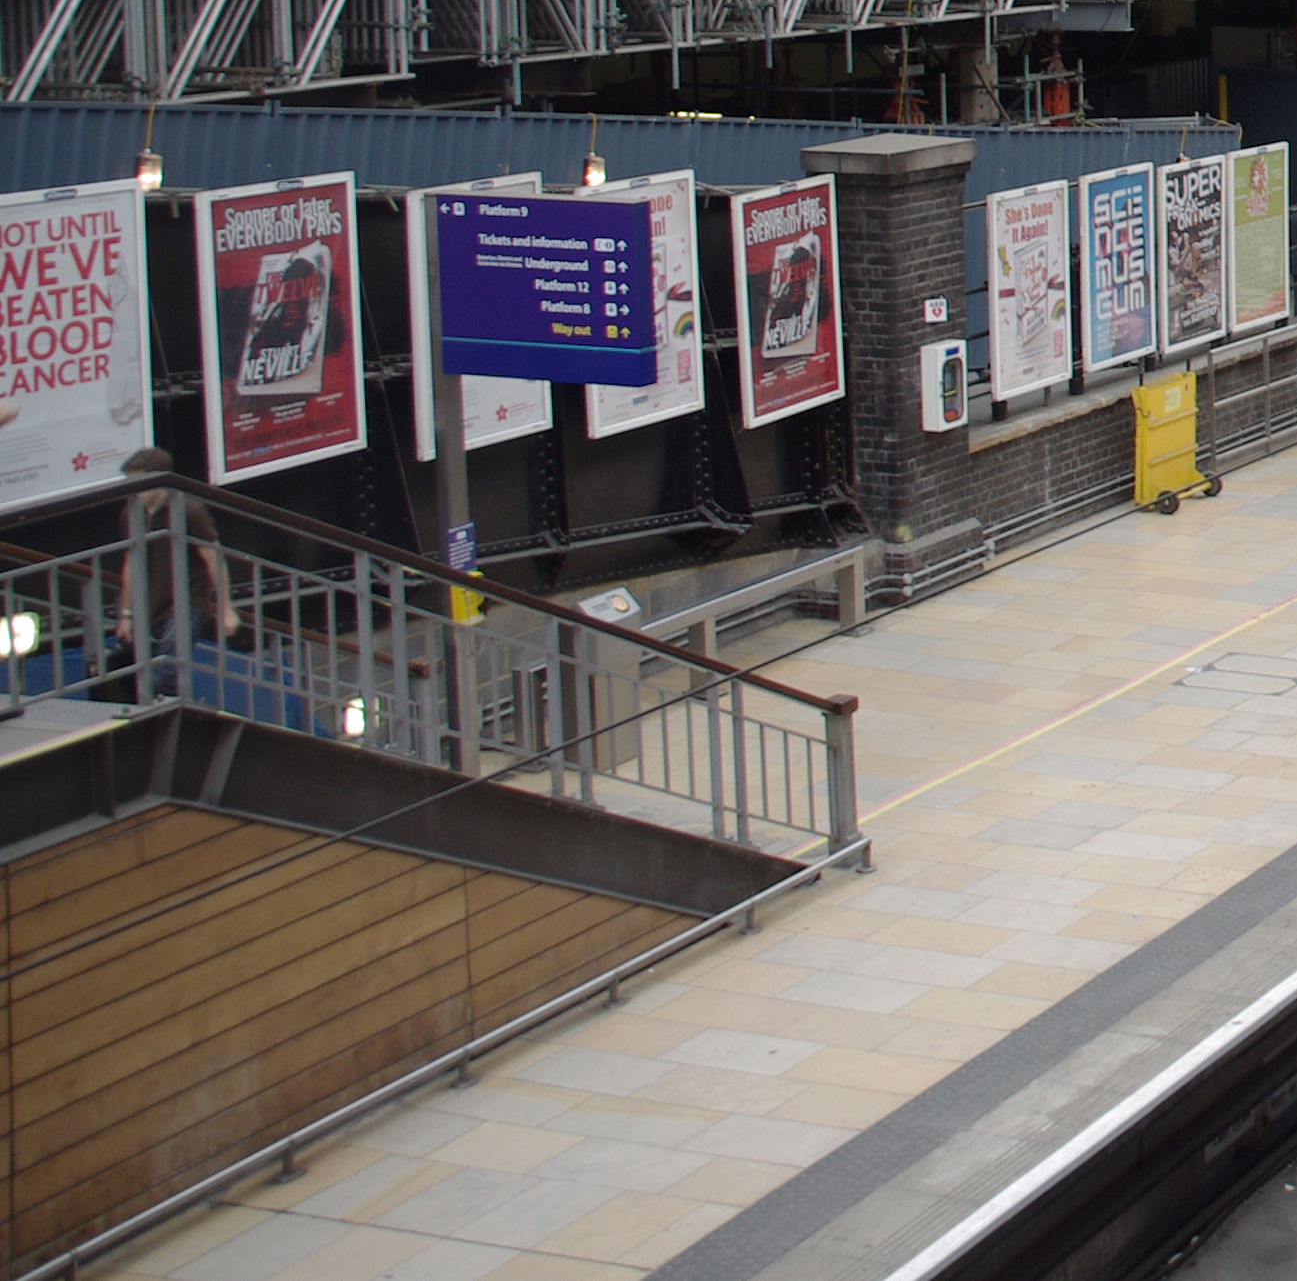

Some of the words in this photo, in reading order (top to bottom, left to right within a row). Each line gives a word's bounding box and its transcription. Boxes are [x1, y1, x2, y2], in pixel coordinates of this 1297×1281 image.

[1166, 165, 1221, 207] SUPER
[225, 205, 278, 230] Sooner
[280, 203, 298, 220] or
[299, 196, 333, 220] later
[479, 203, 520, 217] Platform
[520, 206, 528, 217] 9
[1005, 205, 1030, 225] She's
[1031, 201, 1054, 219] Done
[0, 220, 41, 248] OT
[47, 210, 122, 242] UNTIL
[217, 218, 304, 253] EVERYBODY
[306, 211, 343, 238] PAYS
[746, 215, 802, 246] EVERYBODY
[803, 207, 827, 230] PAYS
[478, 233, 511, 246] Tickets
[512, 235, 531, 248] and
[532, 236, 588, 250] information
[0, 236, 122, 292] WE'VE
[525, 257, 589, 273] Underground
[535, 278, 577, 293] Platform
[577, 281, 590, 294] 12
[0, 282, 113, 328] EATEN
[541, 300, 582, 315] Platform
[552, 322, 573, 337] Way
[573, 325, 592, 336] out
[241, 351, 314, 380] NEVILLE
